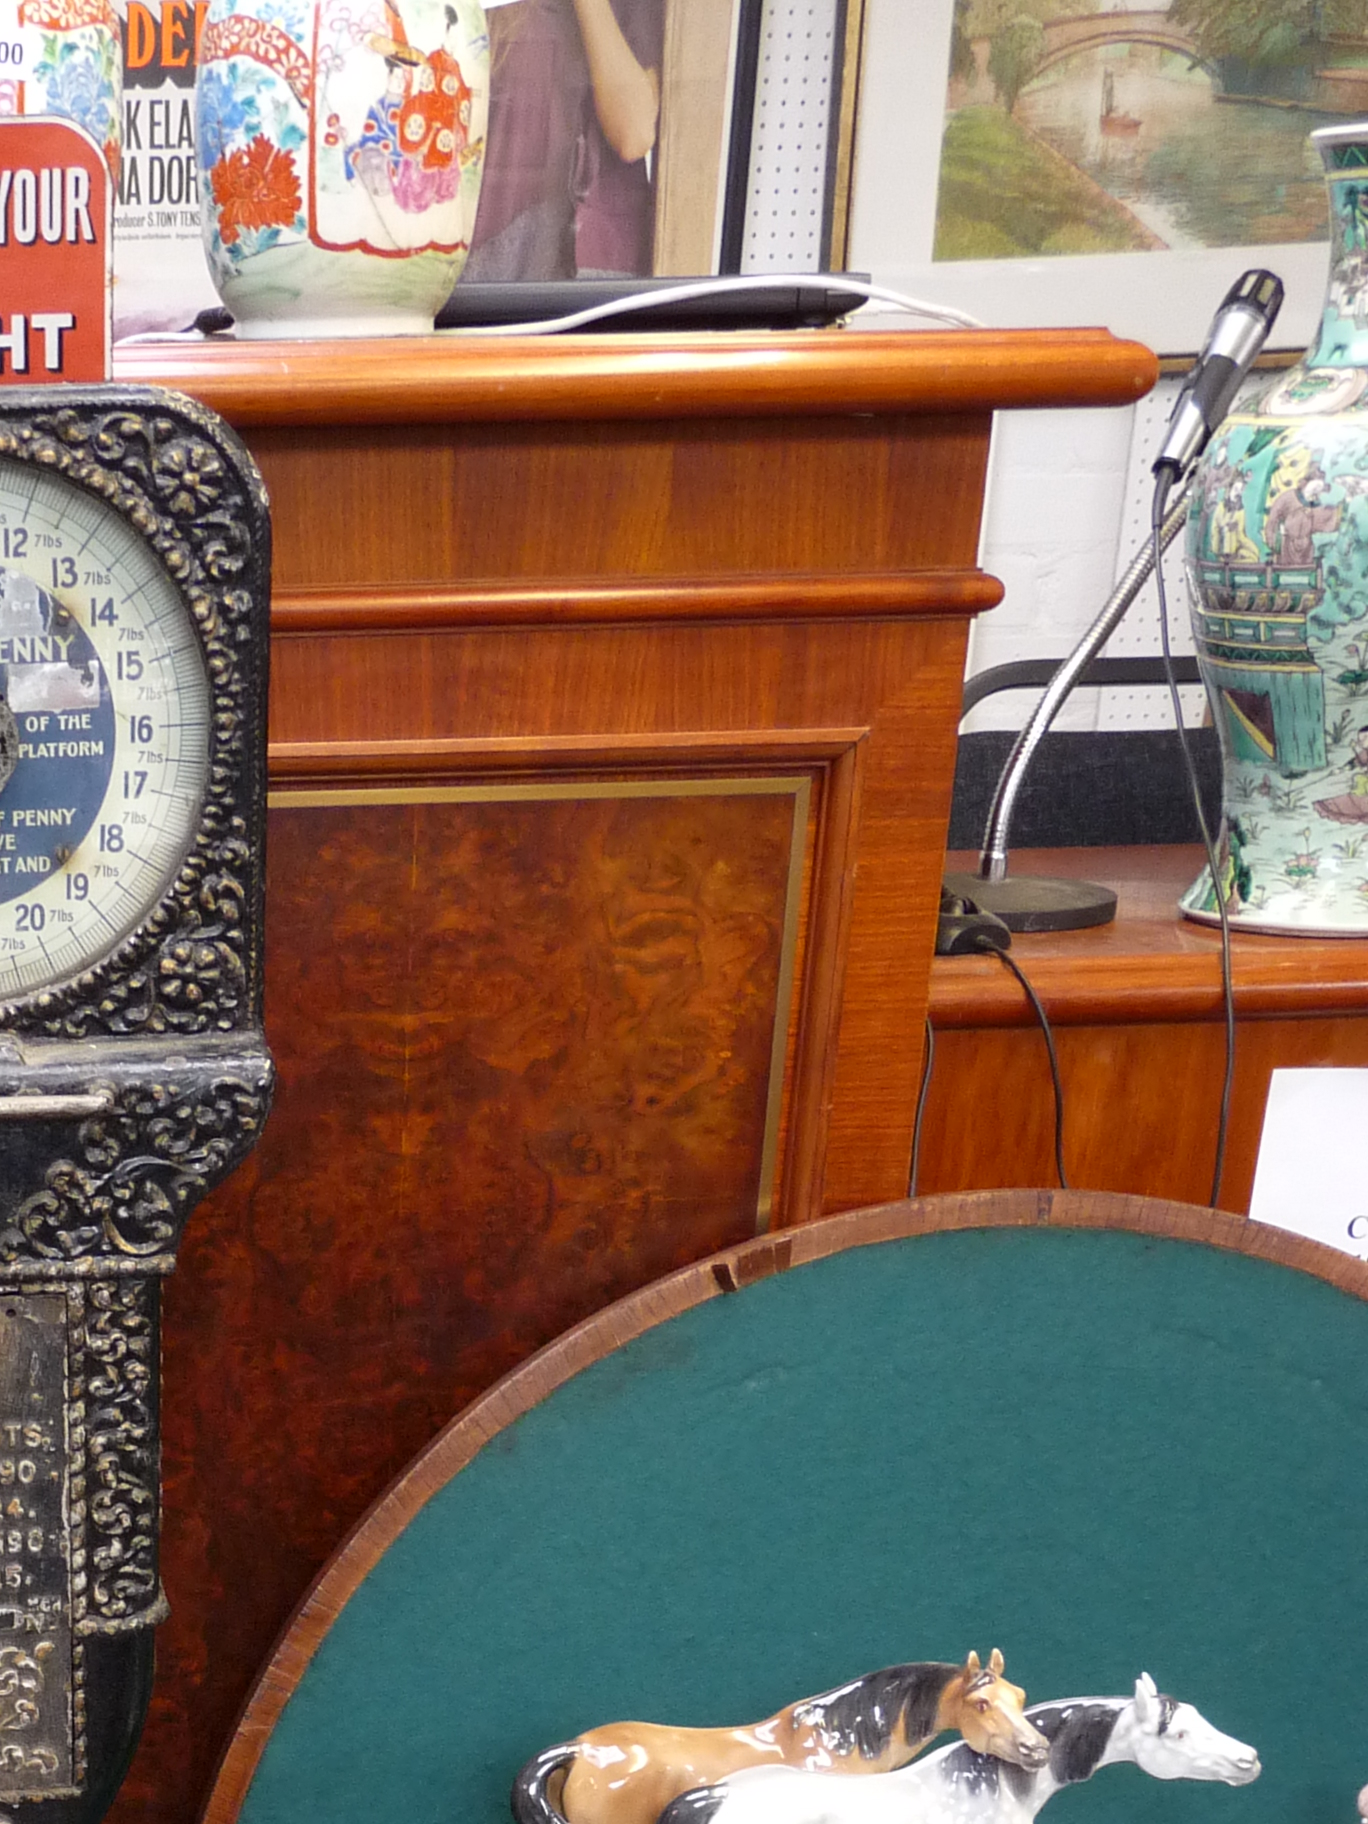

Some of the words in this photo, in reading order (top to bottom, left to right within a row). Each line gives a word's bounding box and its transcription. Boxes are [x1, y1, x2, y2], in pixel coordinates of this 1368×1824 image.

[3, 527, 29, 559] 12
[52, 556, 79, 589] 13
[90, 597, 119, 627] 14
[117, 650, 144, 681] 15
[25, 715, 50, 733] OF
[57, 714, 92, 730] THE
[130, 715, 154, 744] 16
[18, 740, 104, 759] PLATFORM
[123, 770, 149, 799] 17
[12, 807, 76, 827] PENNY
[99, 823, 125, 853] 18
[14, 855, 51, 873] AND
[66, 873, 89, 900] 19
[15, 903, 45, 932] 20
